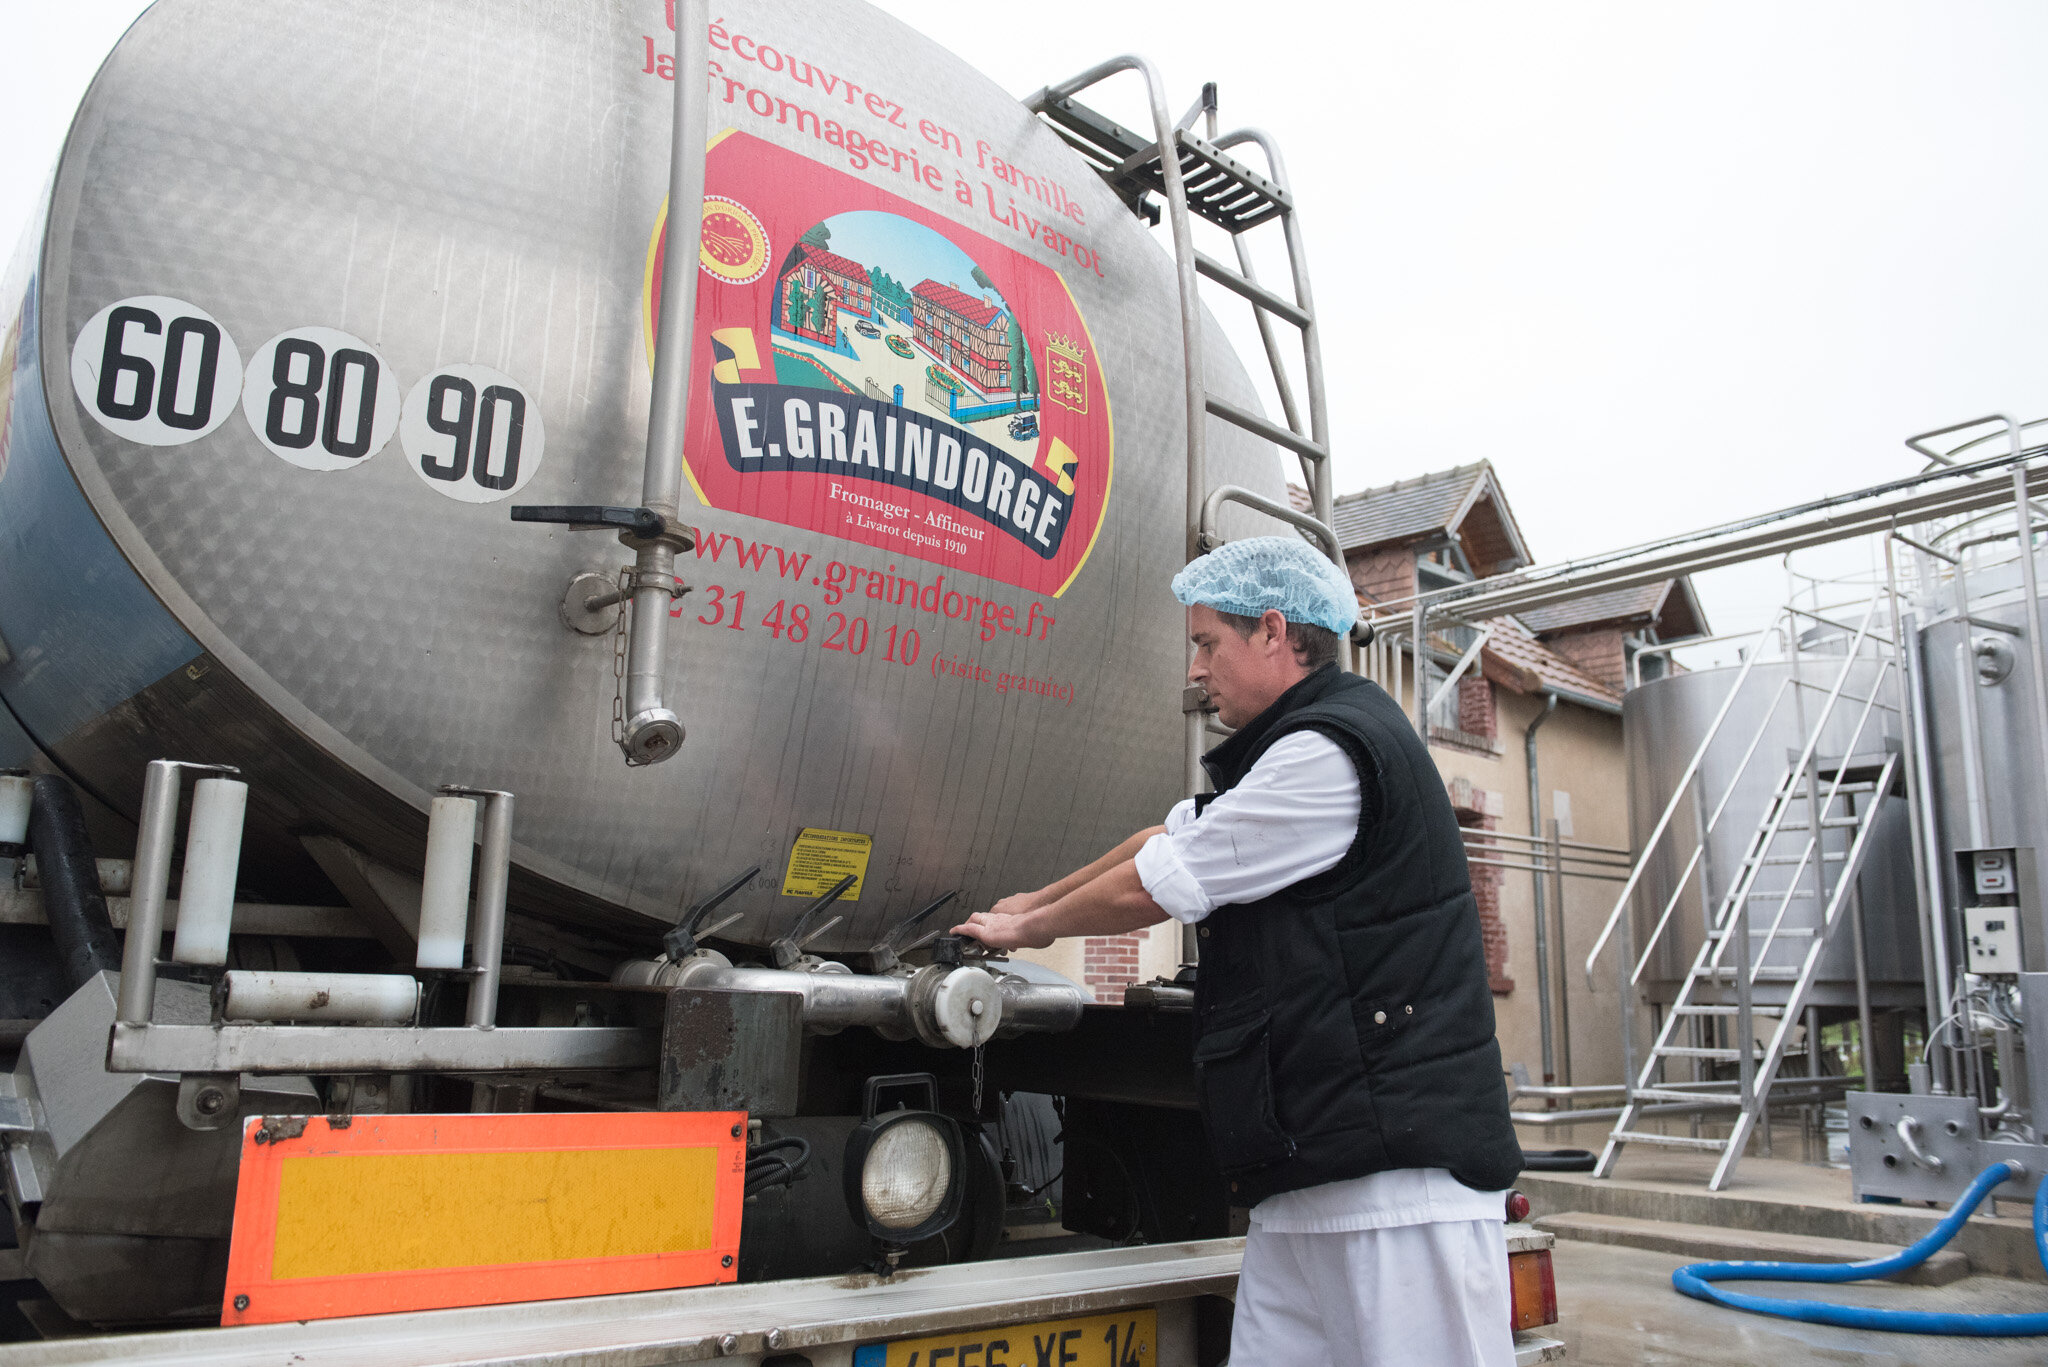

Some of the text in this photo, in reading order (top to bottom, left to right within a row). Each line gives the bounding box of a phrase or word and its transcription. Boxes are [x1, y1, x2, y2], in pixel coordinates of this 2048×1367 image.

[641, 35, 676, 81] la
[955, 169, 974, 208] à
[981, 181, 1105, 279] Livarot
[664, 0, 1086, 226] écouvrez en famille
[96, 305, 221, 431] 60
[265, 337, 380, 459] 80
[420, 374, 527, 491] 90
[731, 397, 1063, 548] E.GRAINDORGE
[828, 482, 911, 519] Fromager
[923, 510, 985, 541] Affineur
[845, 511, 967, 555] à Livarot depuis 1910
[689, 526, 1057, 645] www.graindorge.fr
[697, 585, 746, 632] 31
[761, 600, 811, 644] 48
[821, 612, 870, 656] 20
[882, 624, 921, 667] 10
[931, 651, 992, 683] (visite
[995, 672, 1075, 707] gratuite)
[1103, 1321, 1141, 1367] 14
